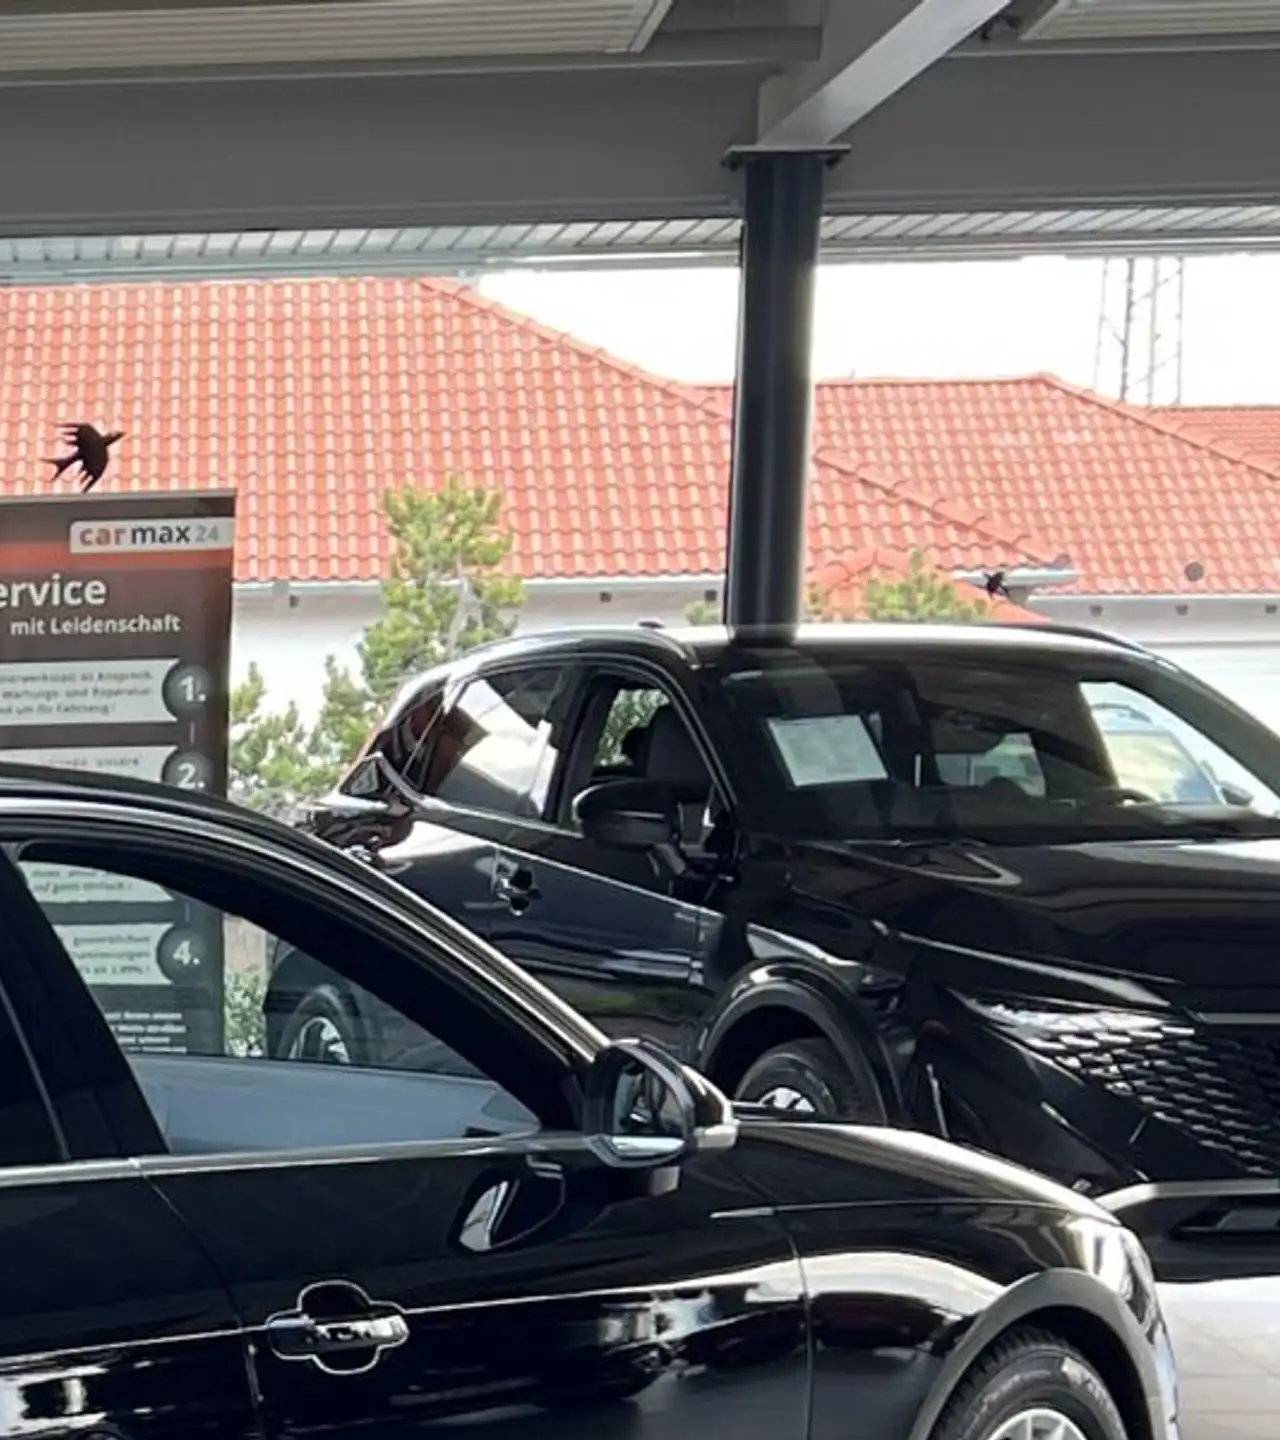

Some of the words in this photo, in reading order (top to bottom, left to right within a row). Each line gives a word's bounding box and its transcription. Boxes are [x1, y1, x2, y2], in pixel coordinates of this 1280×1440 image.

[10, 617, 45, 636] mit
[50, 613, 182, 635] Leidenschaft
[179, 675, 207, 702] 1.
[178, 763, 206, 789] 2.
[173, 940, 201, 966] 4.
